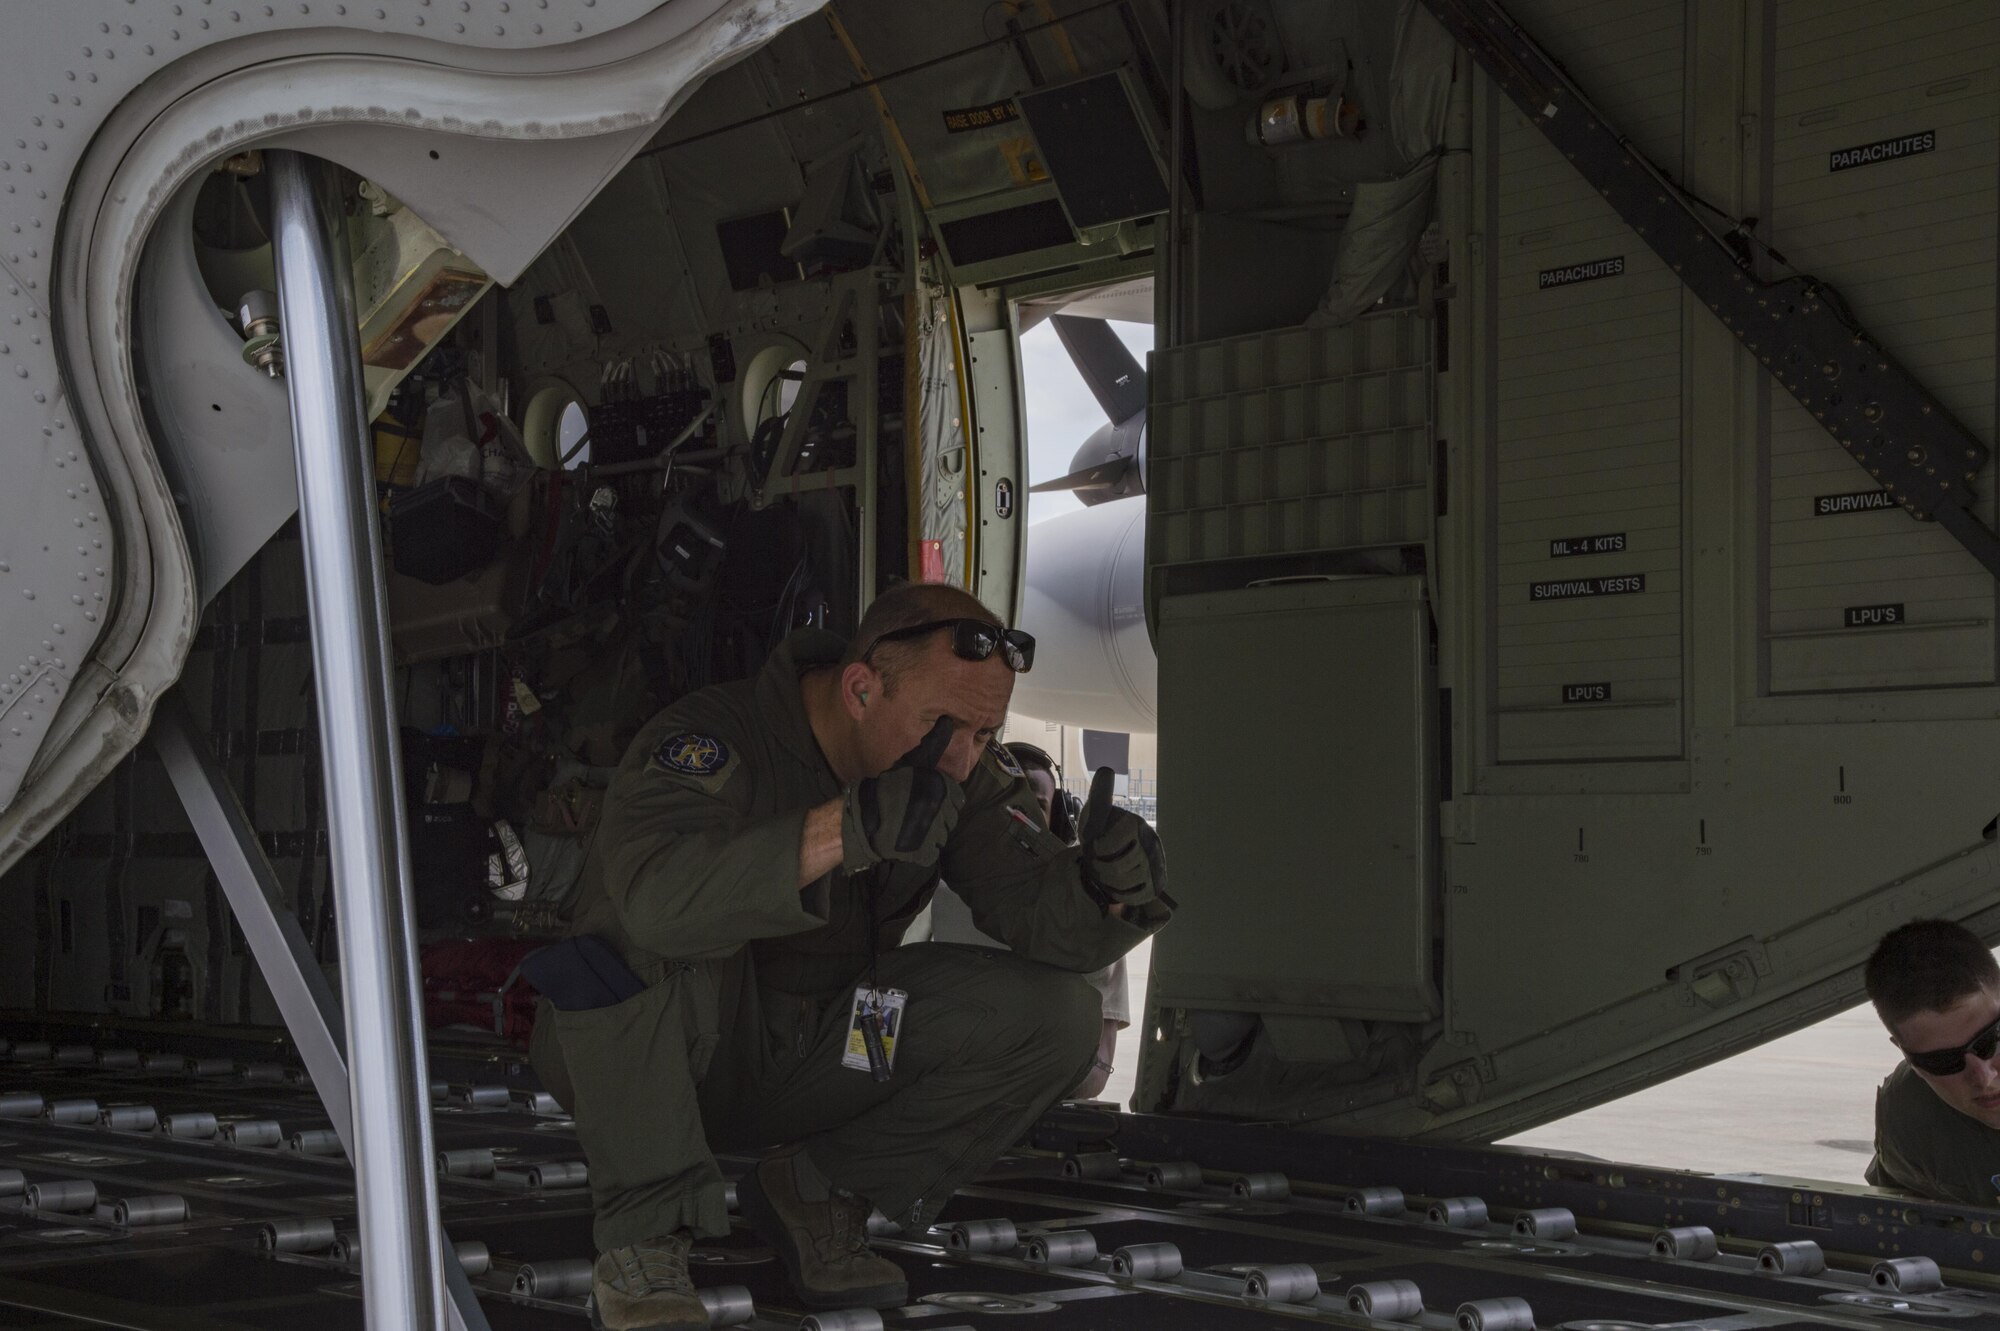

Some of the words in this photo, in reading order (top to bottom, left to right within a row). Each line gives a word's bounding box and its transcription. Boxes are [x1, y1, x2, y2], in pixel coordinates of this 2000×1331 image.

[946, 114, 970, 129] RAISE
[968, 110, 992, 125] DOOR
[992, 105, 1007, 120] BY
[1831, 134, 1933, 169] PARACHUTES
[1540, 259, 1623, 286] PARACHUTES
[1820, 492, 1893, 512] SURVIVAL
[1594, 536, 1623, 551] KITS
[1534, 581, 1594, 597] SURVIVAL
[1599, 577, 1640, 592] VESTS
[1852, 608, 1896, 624] LPU'S
[1568, 686, 1604, 700] LPU'S
[1833, 795, 1852, 804] 800
[1573, 854, 1589, 863] 780
[1695, 847, 1712, 856] 790
